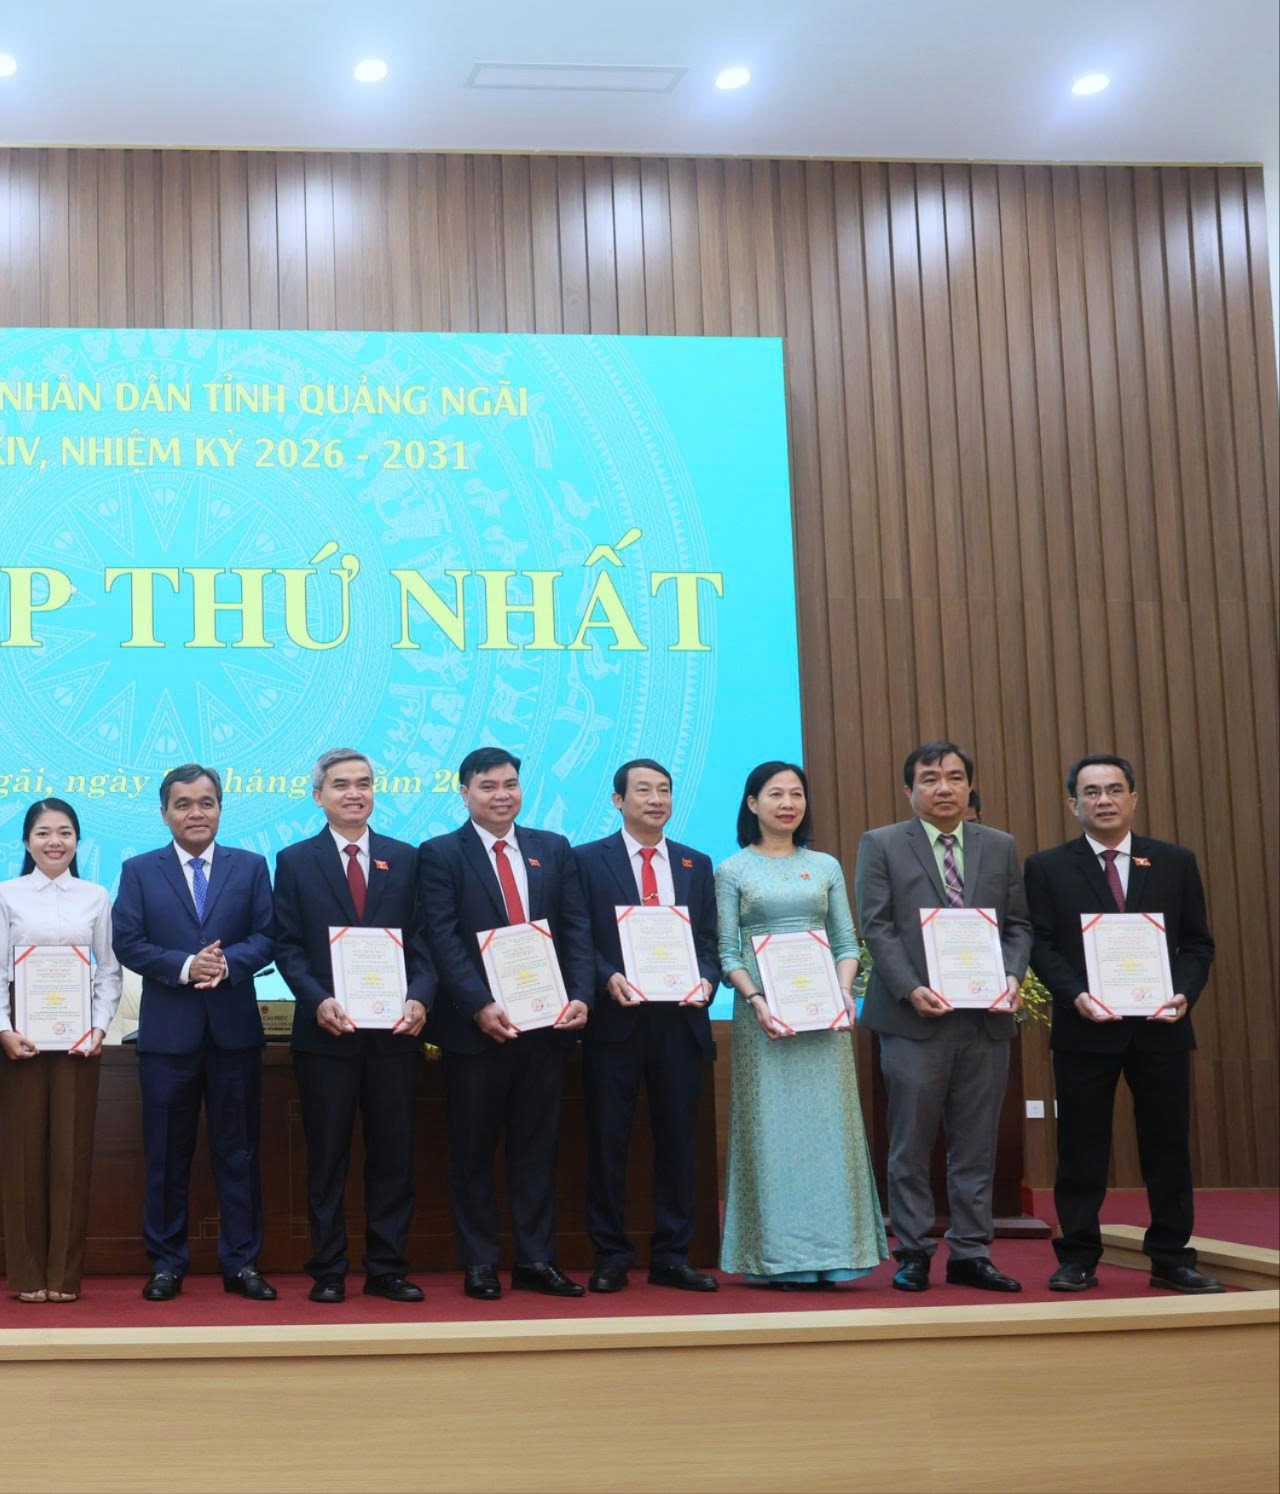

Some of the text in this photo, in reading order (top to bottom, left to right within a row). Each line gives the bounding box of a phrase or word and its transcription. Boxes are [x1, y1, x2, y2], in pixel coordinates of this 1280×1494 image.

[115, 373, 192, 412] DÂN
[203, 373, 286, 414] TỈNH
[298, 374, 428, 417] QUẢNG
[441, 379, 529, 418] NGÃI
[61, 427, 182, 474] NHIỆM
[195, 428, 243, 468] KỲ
[254, 437, 345, 469] 2026
[382, 438, 470, 471] 2031
[103, 540, 362, 651] THỨ
[389, 526, 724, 652] NHẤT
[64, 767, 150, 799] ngày
[222, 767, 312, 800] háng
[371, 767, 423, 794] ăm
